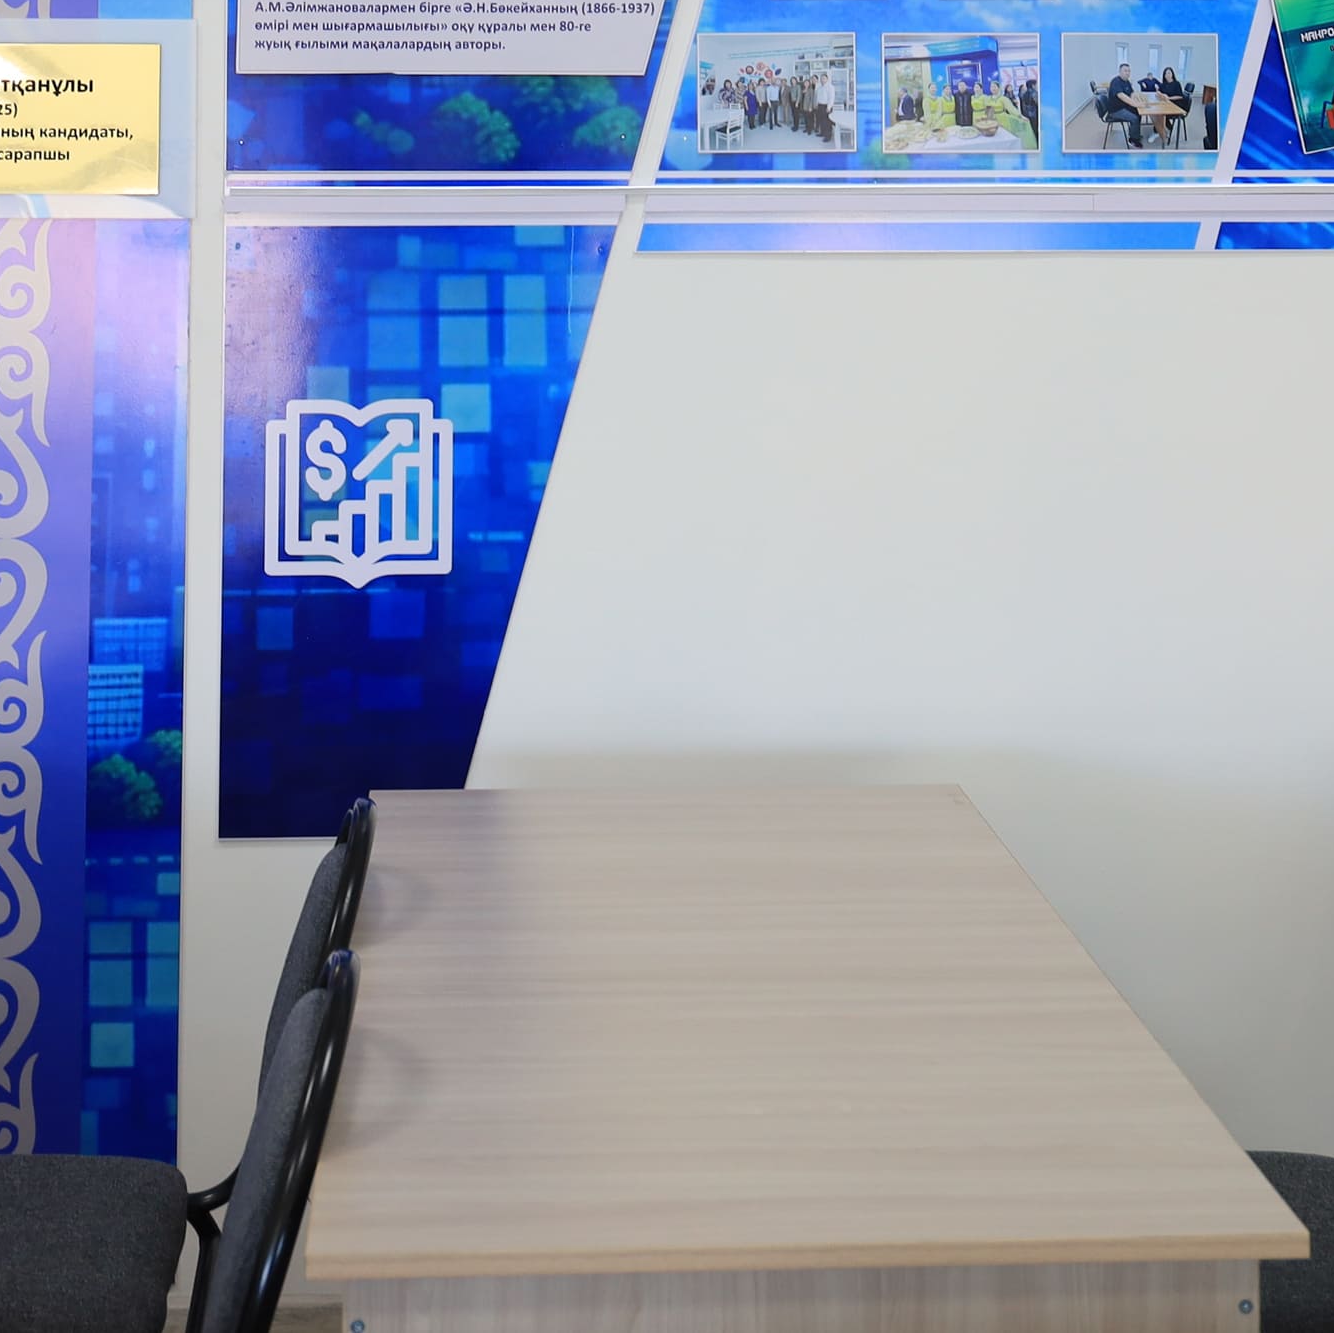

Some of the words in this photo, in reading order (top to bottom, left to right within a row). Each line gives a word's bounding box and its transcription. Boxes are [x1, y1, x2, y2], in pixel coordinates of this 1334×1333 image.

[419, 1, 451, 16] бірге
[581, 1, 655, 17] (1866-1937)
[255, 18, 289, 34] өмірі
[293, 20, 319, 31] мен
[323, 20, 447, 34] шығармашылығы»
[451, 21, 475, 34] оқу
[477, 21, 527, 34] құралы
[529, 21, 555, 32] мен
[559, 19, 591, 32] 80-ге
[255, 38, 291, 52] жуық
[295, 38, 349, 49] ғылыми
[351, 38, 451, 52] мақалалардың
[455, 39, 505, 52] авторы.
[39, 126, 134, 141] кандидаты,
